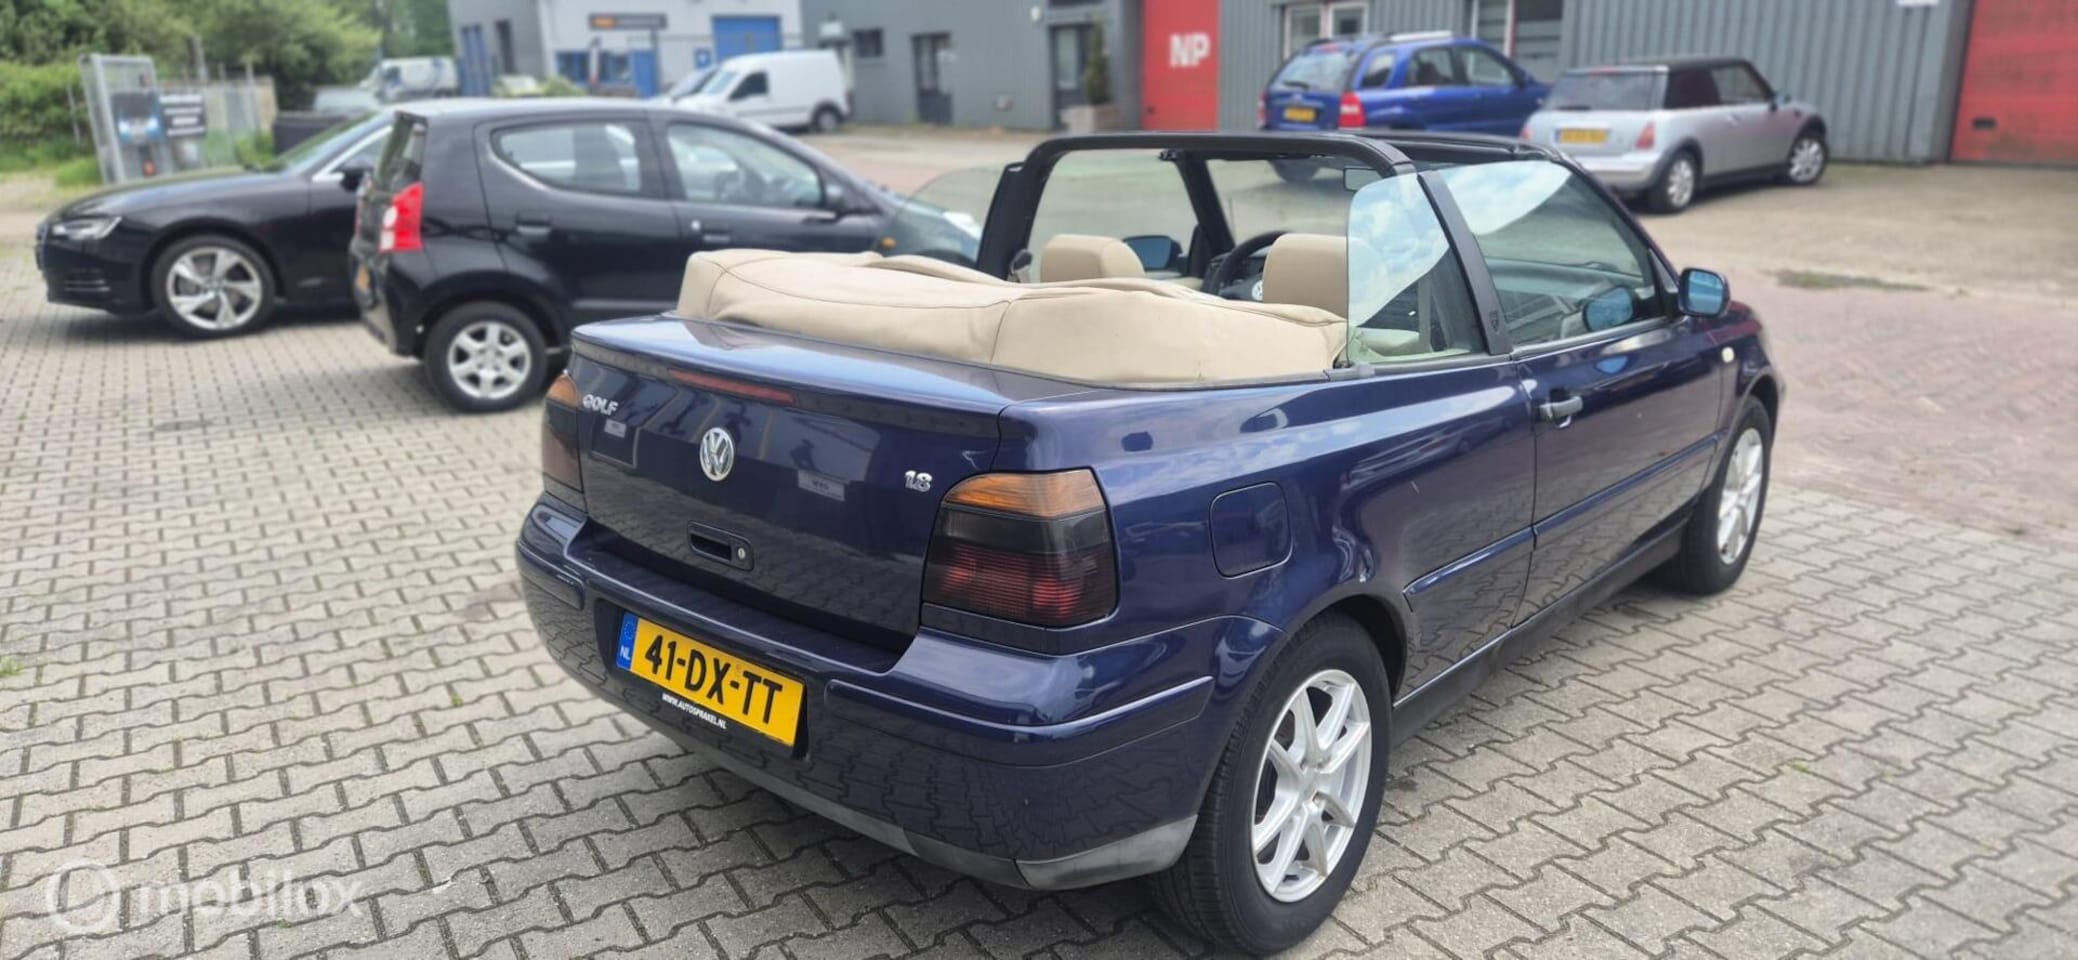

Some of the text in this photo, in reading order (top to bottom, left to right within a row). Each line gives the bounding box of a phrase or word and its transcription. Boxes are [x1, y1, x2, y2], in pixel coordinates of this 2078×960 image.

[1169, 32, 1210, 68] NP
[583, 394, 619, 415] GOLF
[620, 645, 631, 661] NL
[644, 634, 783, 725] 41-DX-TT
